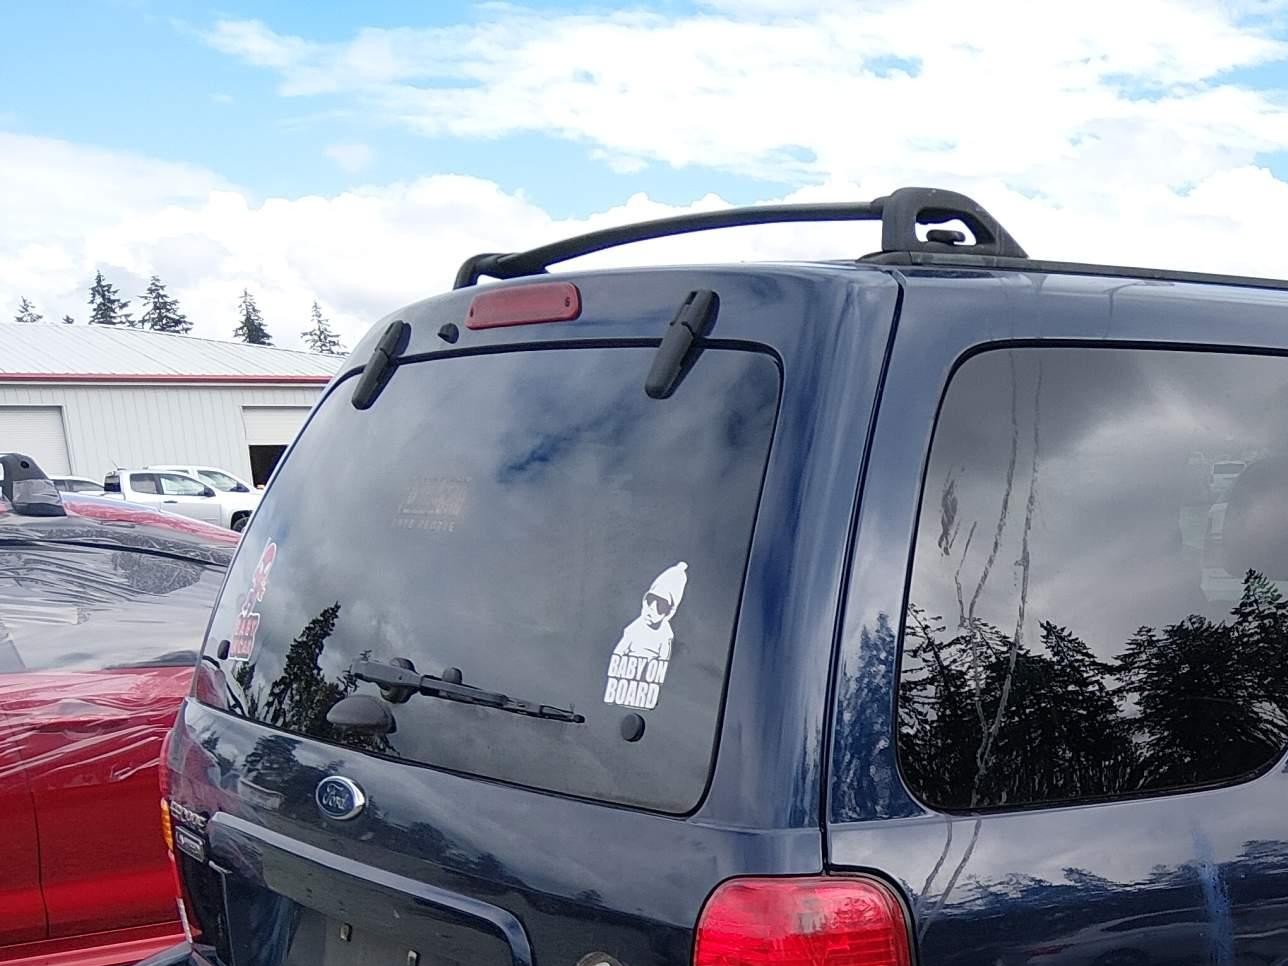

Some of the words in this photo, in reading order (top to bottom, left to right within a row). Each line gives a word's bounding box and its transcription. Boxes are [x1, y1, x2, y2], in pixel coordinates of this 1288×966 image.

[608, 654, 648, 680] BABY
[645, 660, 669, 684] ON
[604, 678, 660, 709] BOARD
[322, 782, 351, 811] Ford
